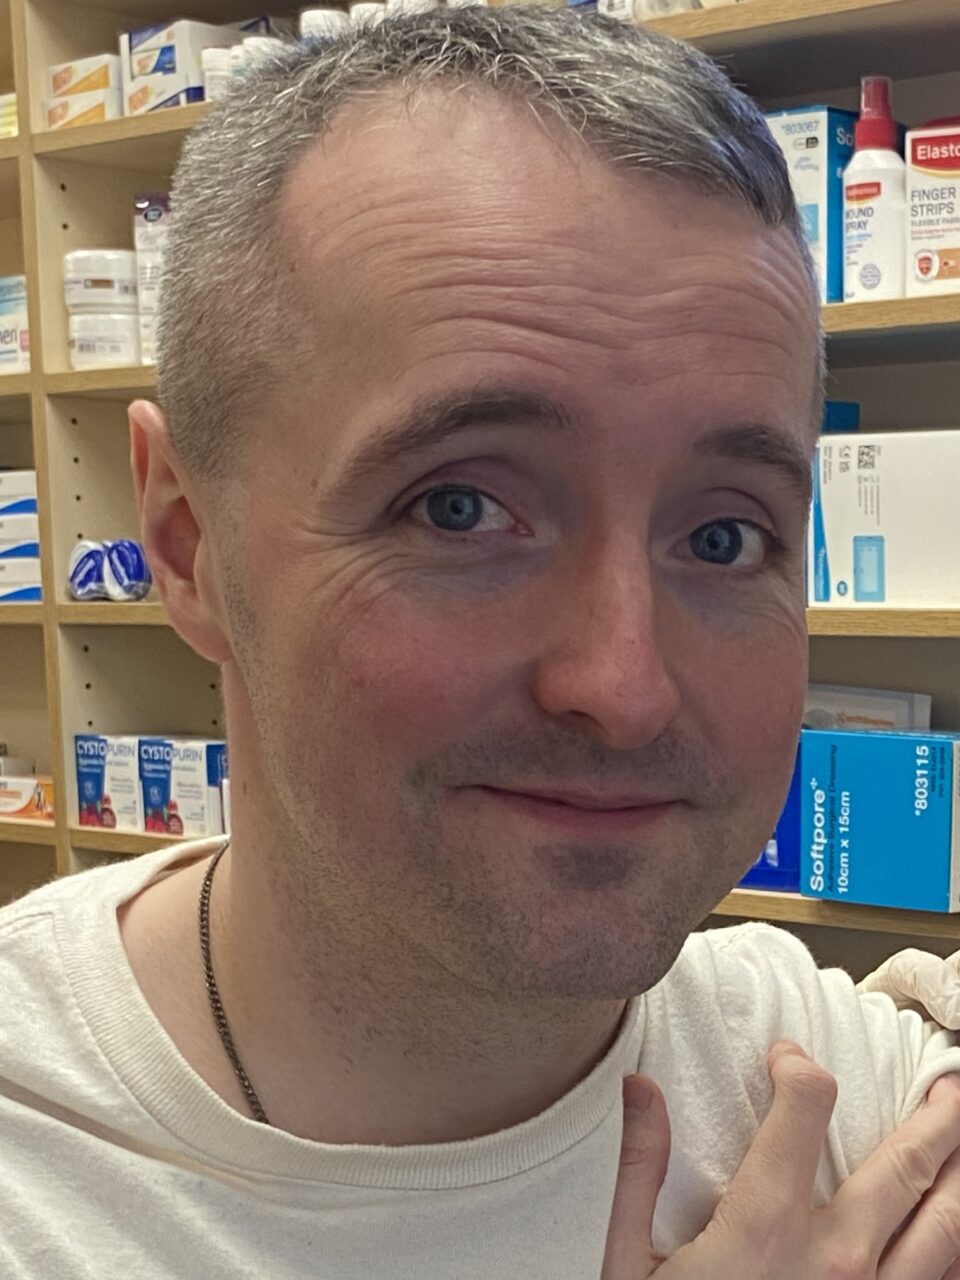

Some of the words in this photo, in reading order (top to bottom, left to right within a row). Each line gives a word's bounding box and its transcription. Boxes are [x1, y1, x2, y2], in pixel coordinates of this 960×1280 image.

[911, 187, 957, 201] FINGER
[911, 202, 954, 217] STRIPS
[846, 220, 868, 233] PRAY
[77, 741, 135, 757] CYSTOPURIN
[140, 745, 203, 761] CYSTOPURIN
[839, 791, 850, 833] 15cm
[840, 838, 849, 848] x
[837, 852, 849, 894] 10cm
